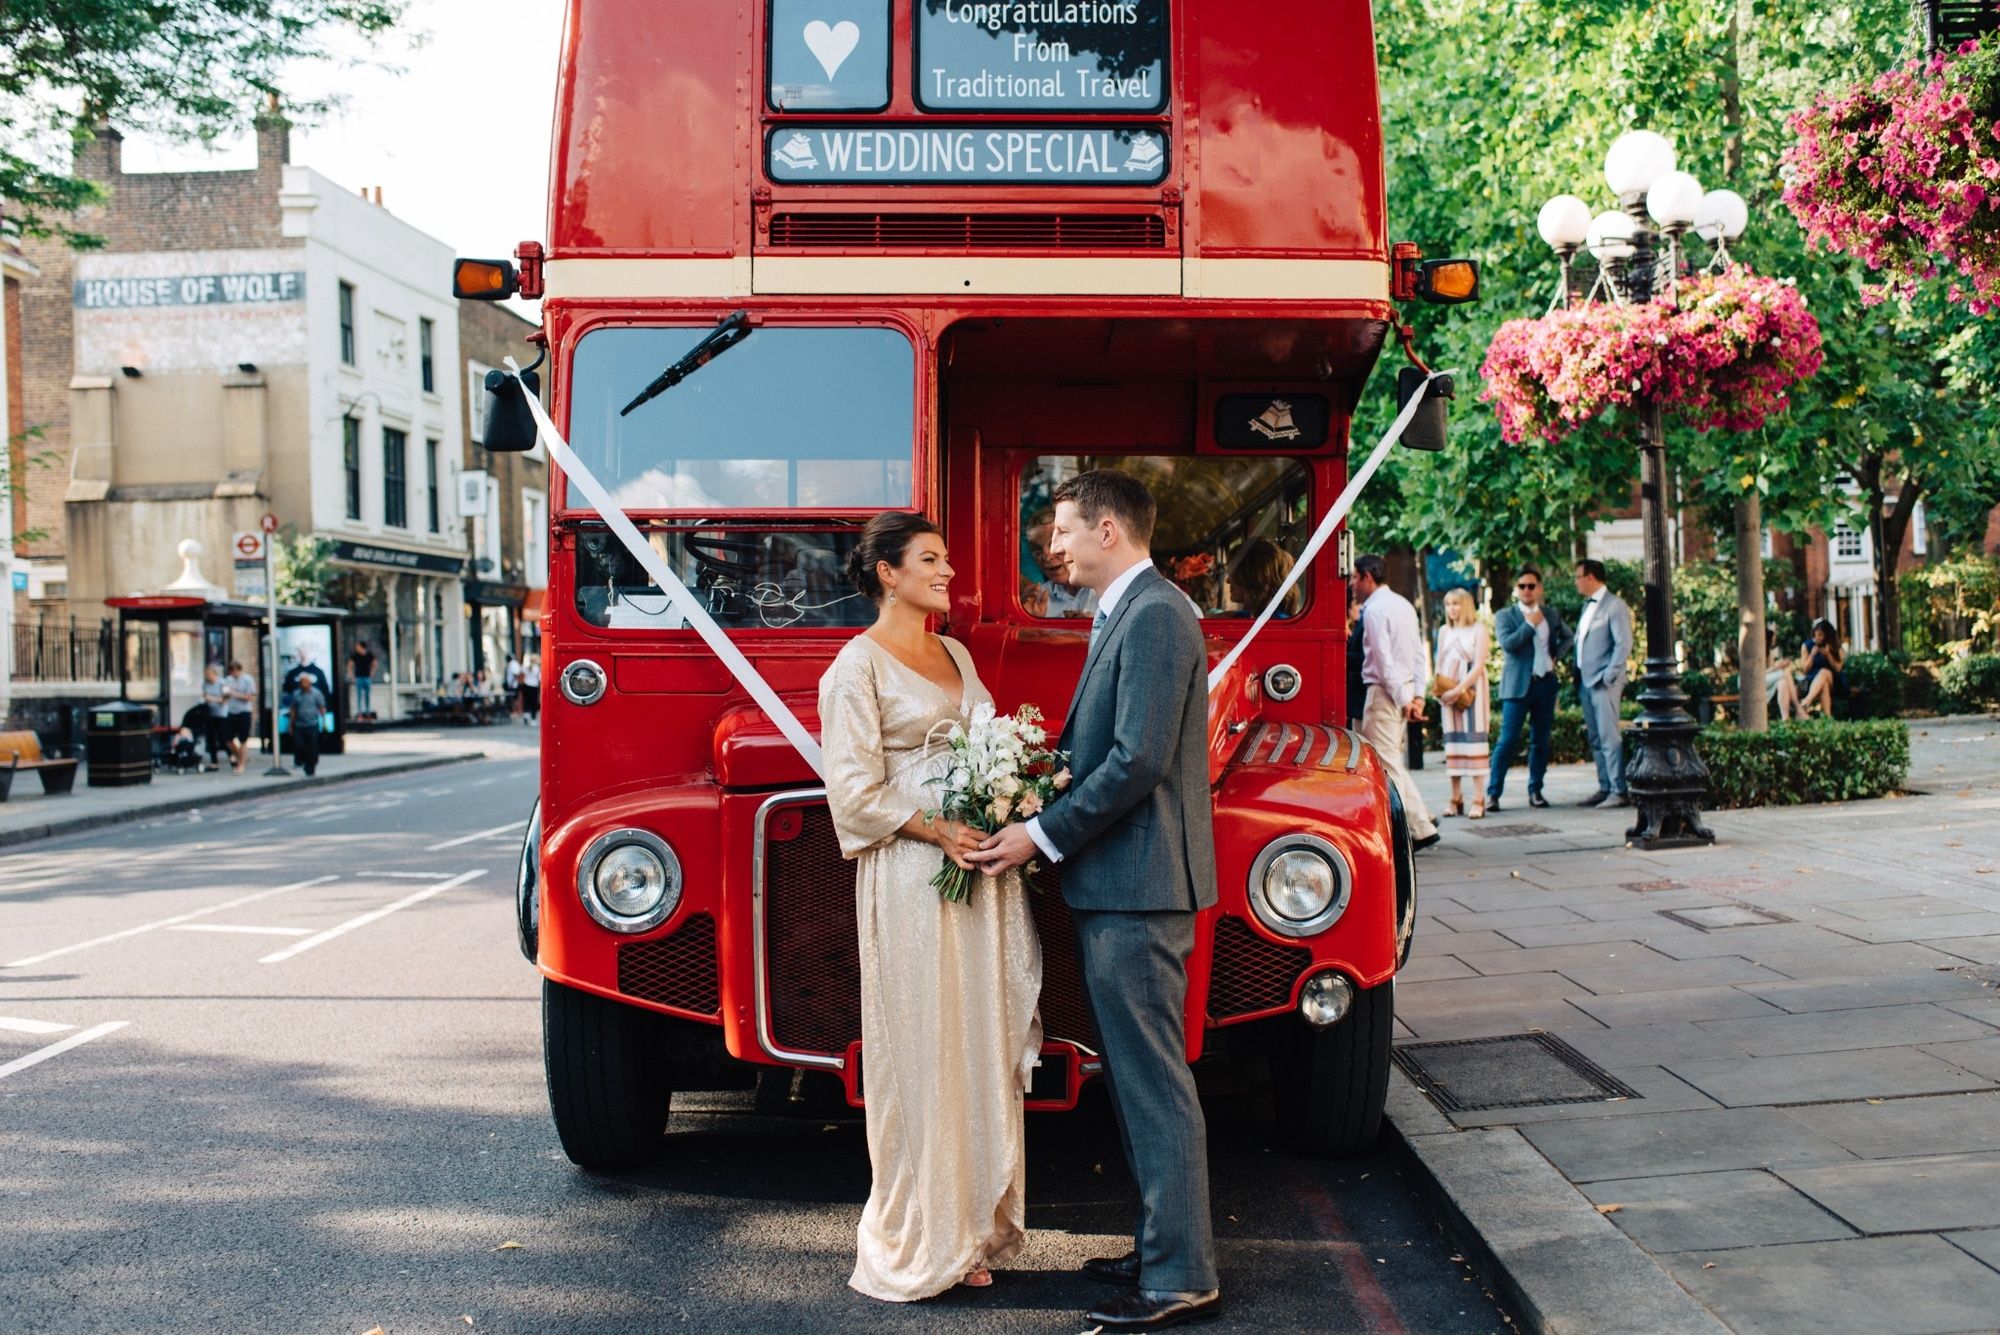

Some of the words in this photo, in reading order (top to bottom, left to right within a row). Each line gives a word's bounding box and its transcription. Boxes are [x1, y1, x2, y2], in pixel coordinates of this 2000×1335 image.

[945, 0, 1137, 29] Congratulations
[1014, 33, 1069, 62] From
[932, 69, 1065, 97] Traditional
[1076, 69, 1151, 98] Travel
[821, 132, 975, 172] WEDDING
[985, 132, 1118, 173] SPECIAL
[85, 280, 172, 307] HOUSE
[180, 277, 216, 304] OF
[222, 273, 295, 302] WOLF
